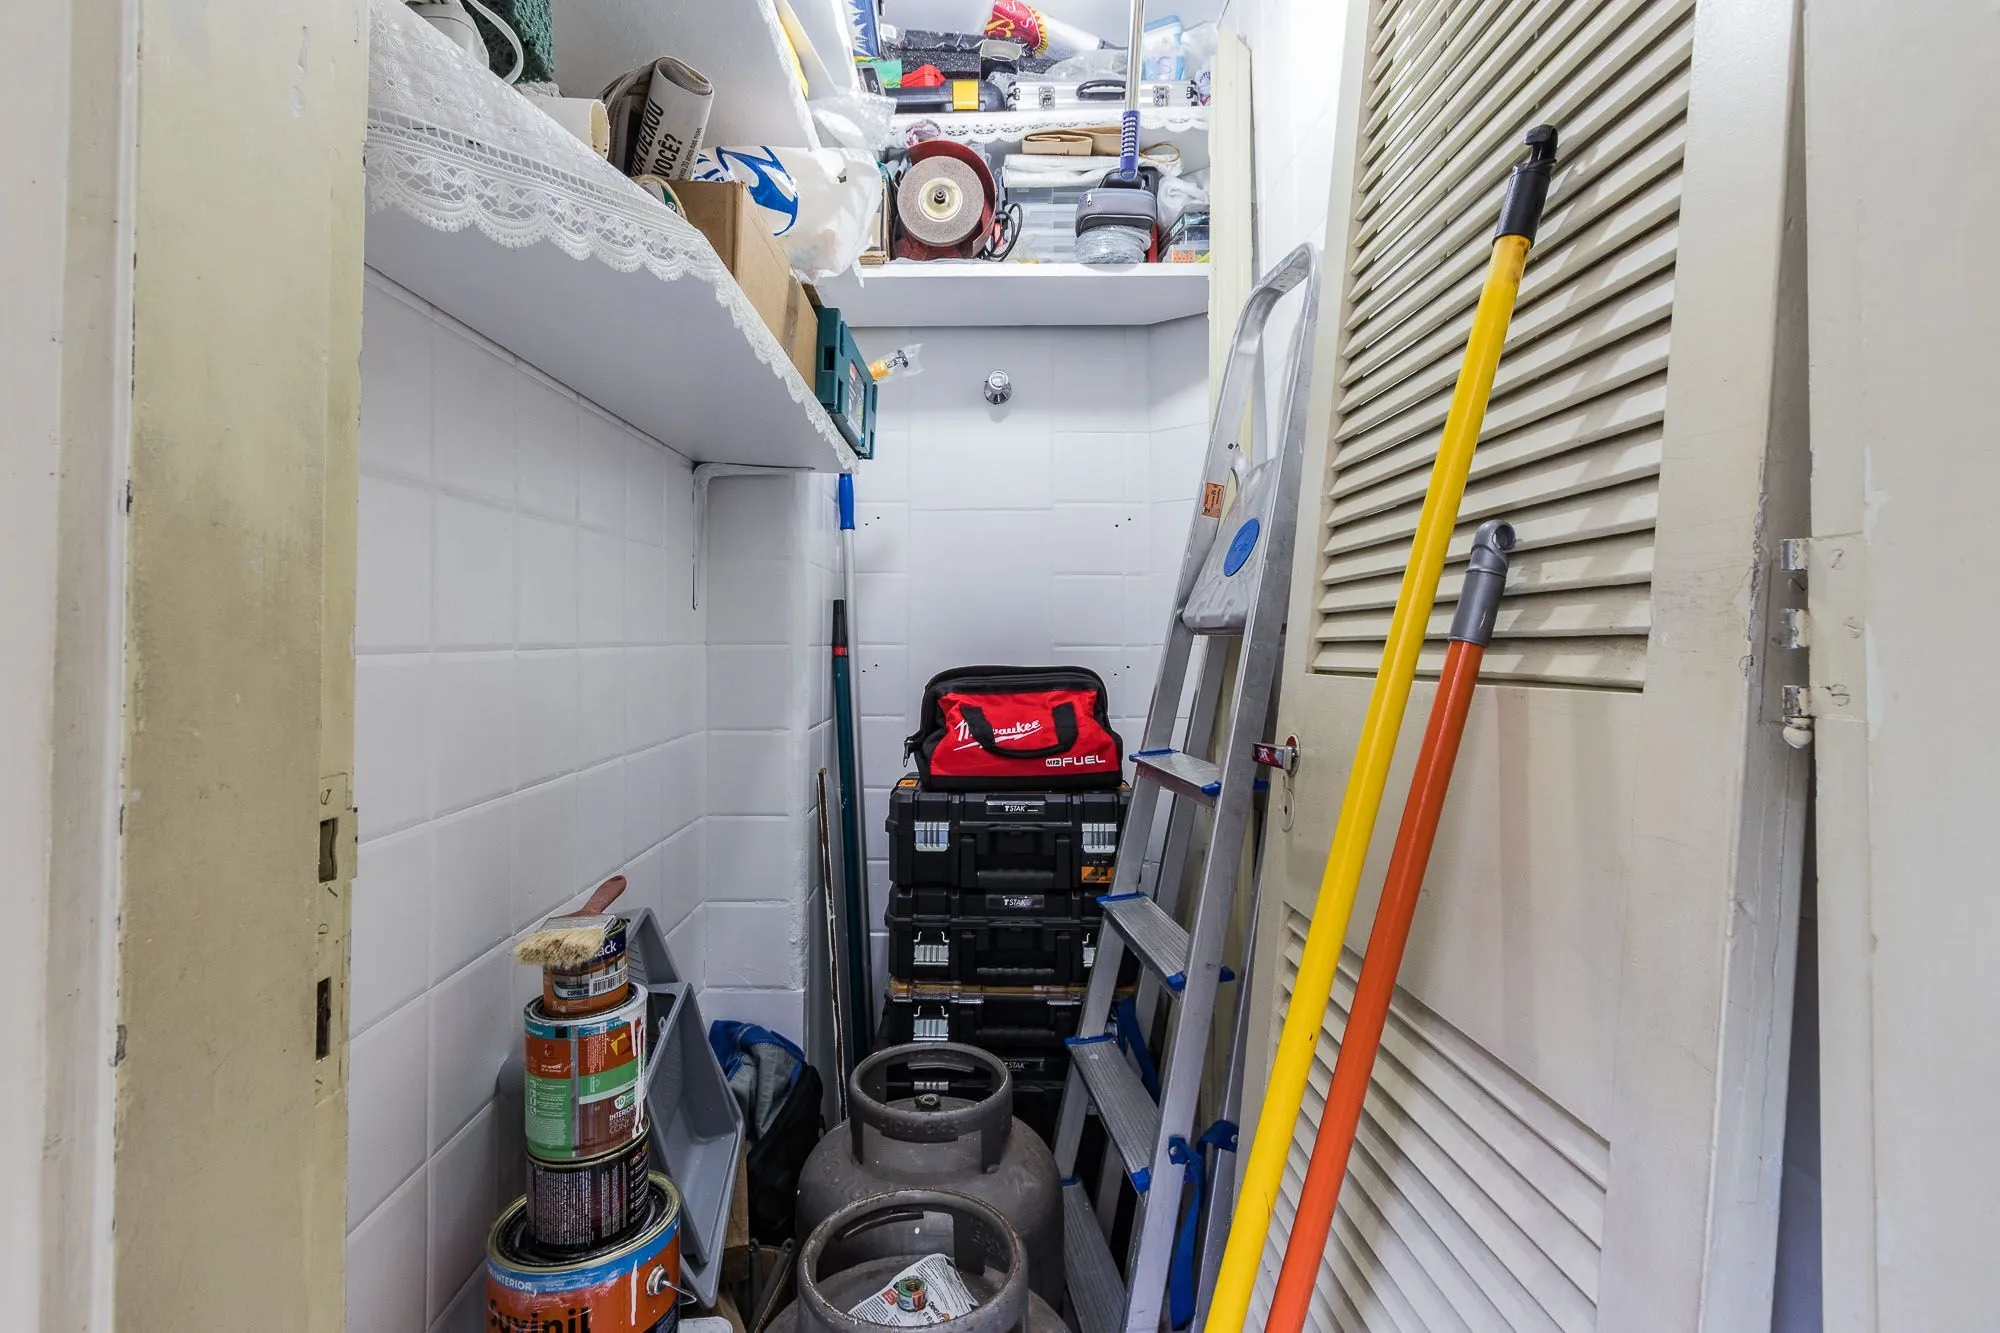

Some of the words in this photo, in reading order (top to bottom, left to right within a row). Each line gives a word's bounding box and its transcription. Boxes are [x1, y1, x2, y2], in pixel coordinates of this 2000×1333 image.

[639, 97, 664, 155] DEIXOU
[651, 133, 683, 178] VOCÊ?
[954, 720, 1041, 742] Mwaukee
[1063, 755, 1106, 767] FUEL
[594, 940, 617, 958] ack
[609, 1104, 634, 1121] INTEROR
